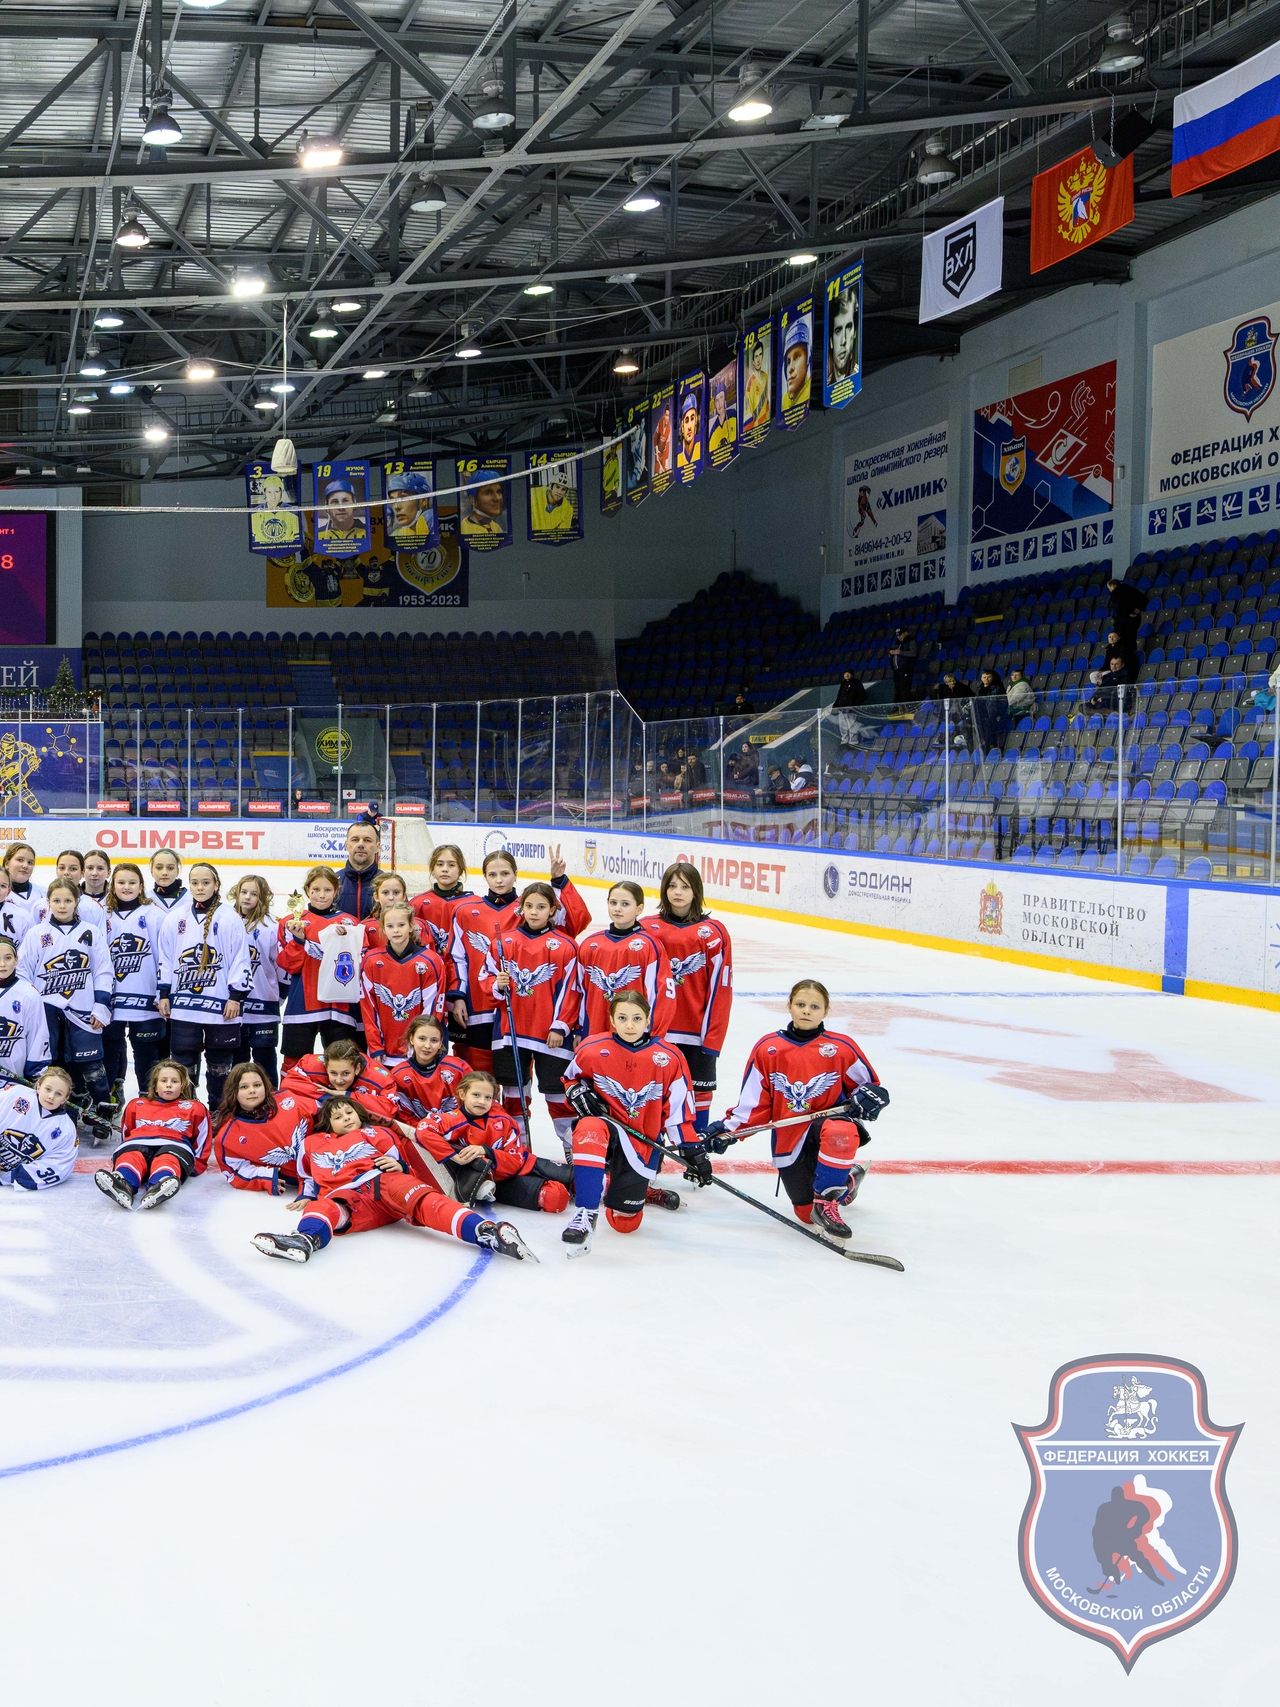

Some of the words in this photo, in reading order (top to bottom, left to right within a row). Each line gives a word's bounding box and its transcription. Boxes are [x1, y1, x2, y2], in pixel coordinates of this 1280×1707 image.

[945, 242, 974, 276] ВХЛ
[827, 277, 840, 302] 11
[781, 312, 788, 328] 4
[744, 332, 754, 350] 19
[680, 380, 685, 394] 7
[652, 392, 662, 409] 22
[628, 408, 634, 424] 8
[854, 447, 906, 472] Воскресенская
[907, 430, 946, 452] хоккейная
[1002, 441, 1024, 454] ХИМИК
[1171, 430, 1264, 465] ФЕДЕРАЦИЯ
[384, 462, 404, 476] 13
[457, 460, 478, 472] 16
[530, 454, 547, 466] 14
[252, 466, 263, 478] 3
[317, 465, 332, 478] 19
[846, 470, 869, 486] школа
[870, 454, 922, 479] олимпийского
[1160, 453, 1262, 492] МОСКОВСКОЙ
[0, 554, 14, 570] 8
[420, 548, 436, 564] 70
[398, 595, 461, 606] 1953-2023
[96, 830, 266, 850] OLIMPBET
[507, 842, 545, 860] БУРЭНЕРГО
[602, 846, 664, 881] voshimik.ru
[848, 870, 912, 894] ЗОДИАК
[848, 890, 890, 902] ДОМОСТРОИТЕЛЬНАЯ
[890, 896, 912, 904] ФАБРИКА
[1023, 894, 1146, 922] ПРАВИТЕЛЬСТВО
[1022, 911, 1120, 937] МОСКОВСКОЙ
[1022, 928, 1086, 950] ОБЛАСТИ
[666, 978, 676, 996] 9
[436, 994, 445, 1013] 8
[860, 1086, 885, 1105] CCM
[36, 1167, 61, 1185] 30
[404, 1184, 433, 1202] BAUER
